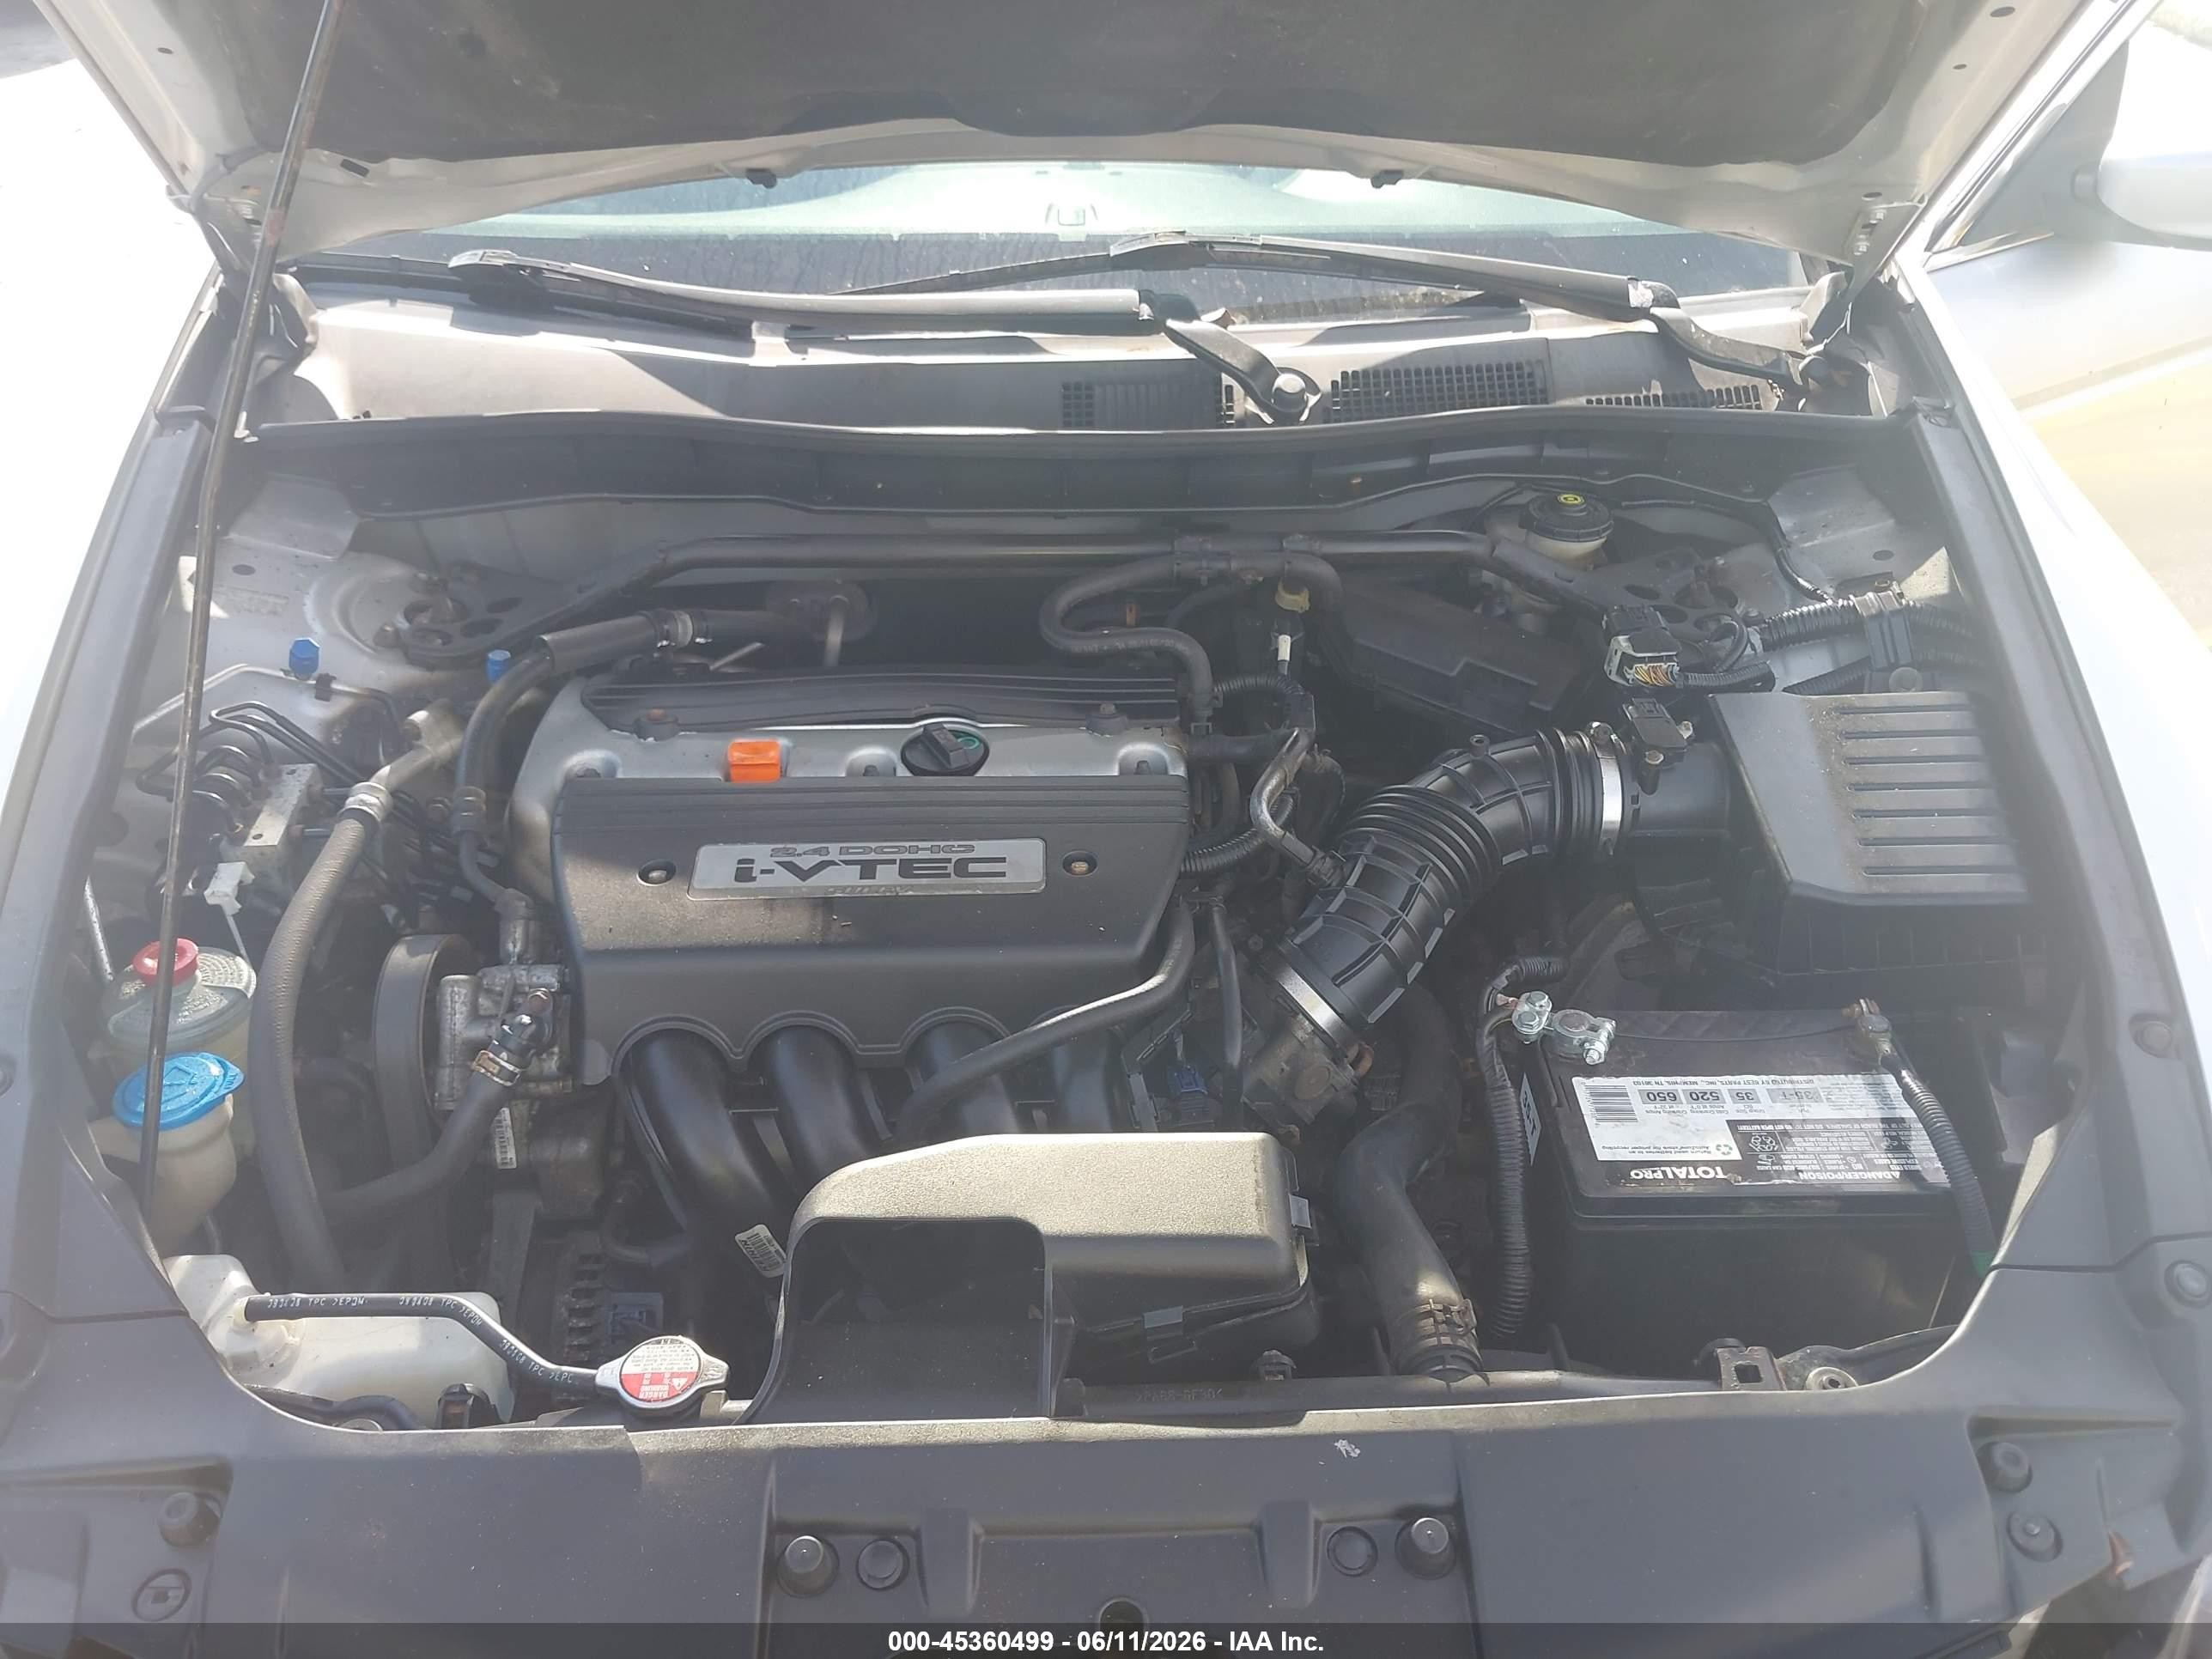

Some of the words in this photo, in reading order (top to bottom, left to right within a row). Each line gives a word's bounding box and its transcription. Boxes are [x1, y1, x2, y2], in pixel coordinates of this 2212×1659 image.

[769, 845, 830, 857] 2.4
[839, 844, 975, 855] DOHC
[734, 856, 1007, 883] i-VTEC
[1646, 1091, 1677, 1102] 650
[1689, 1091, 1721, 1102] 520
[1735, 1091, 1754, 1101] 35
[1630, 1166, 1728, 1180] TOTALPRO
[1798, 1170, 1892, 1180] DANGER/POISON
